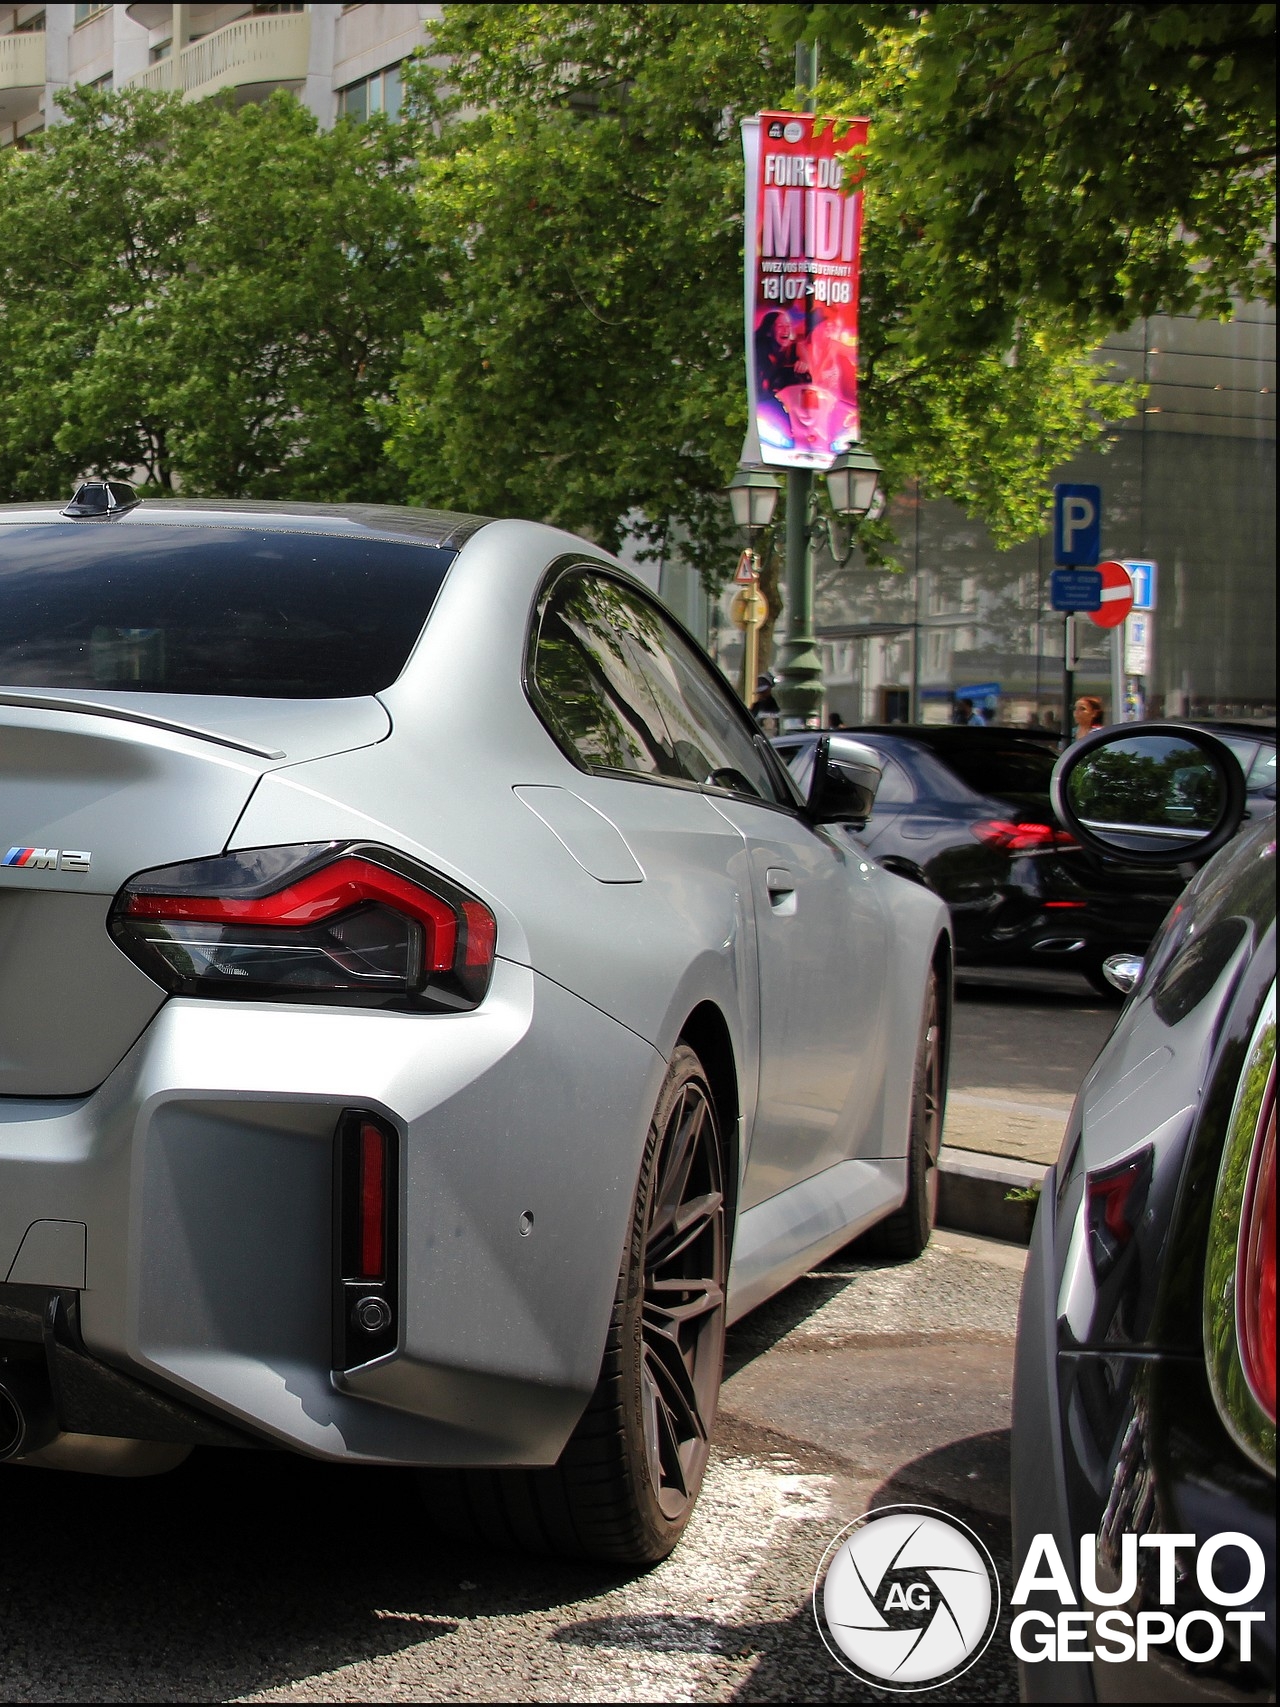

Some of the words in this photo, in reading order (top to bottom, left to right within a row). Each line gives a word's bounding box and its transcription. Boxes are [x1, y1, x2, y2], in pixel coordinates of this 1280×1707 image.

[765, 154, 815, 187] FOIRE
[817, 158, 841, 190] DU
[762, 189, 856, 262] MIDI
[762, 262, 781, 273] VIVEZ
[782, 262, 797, 273] VOS
[1062, 497, 1094, 553] P
[22, 848, 92, 873] M2
[631, 1119, 658, 1260] MICHELIN
